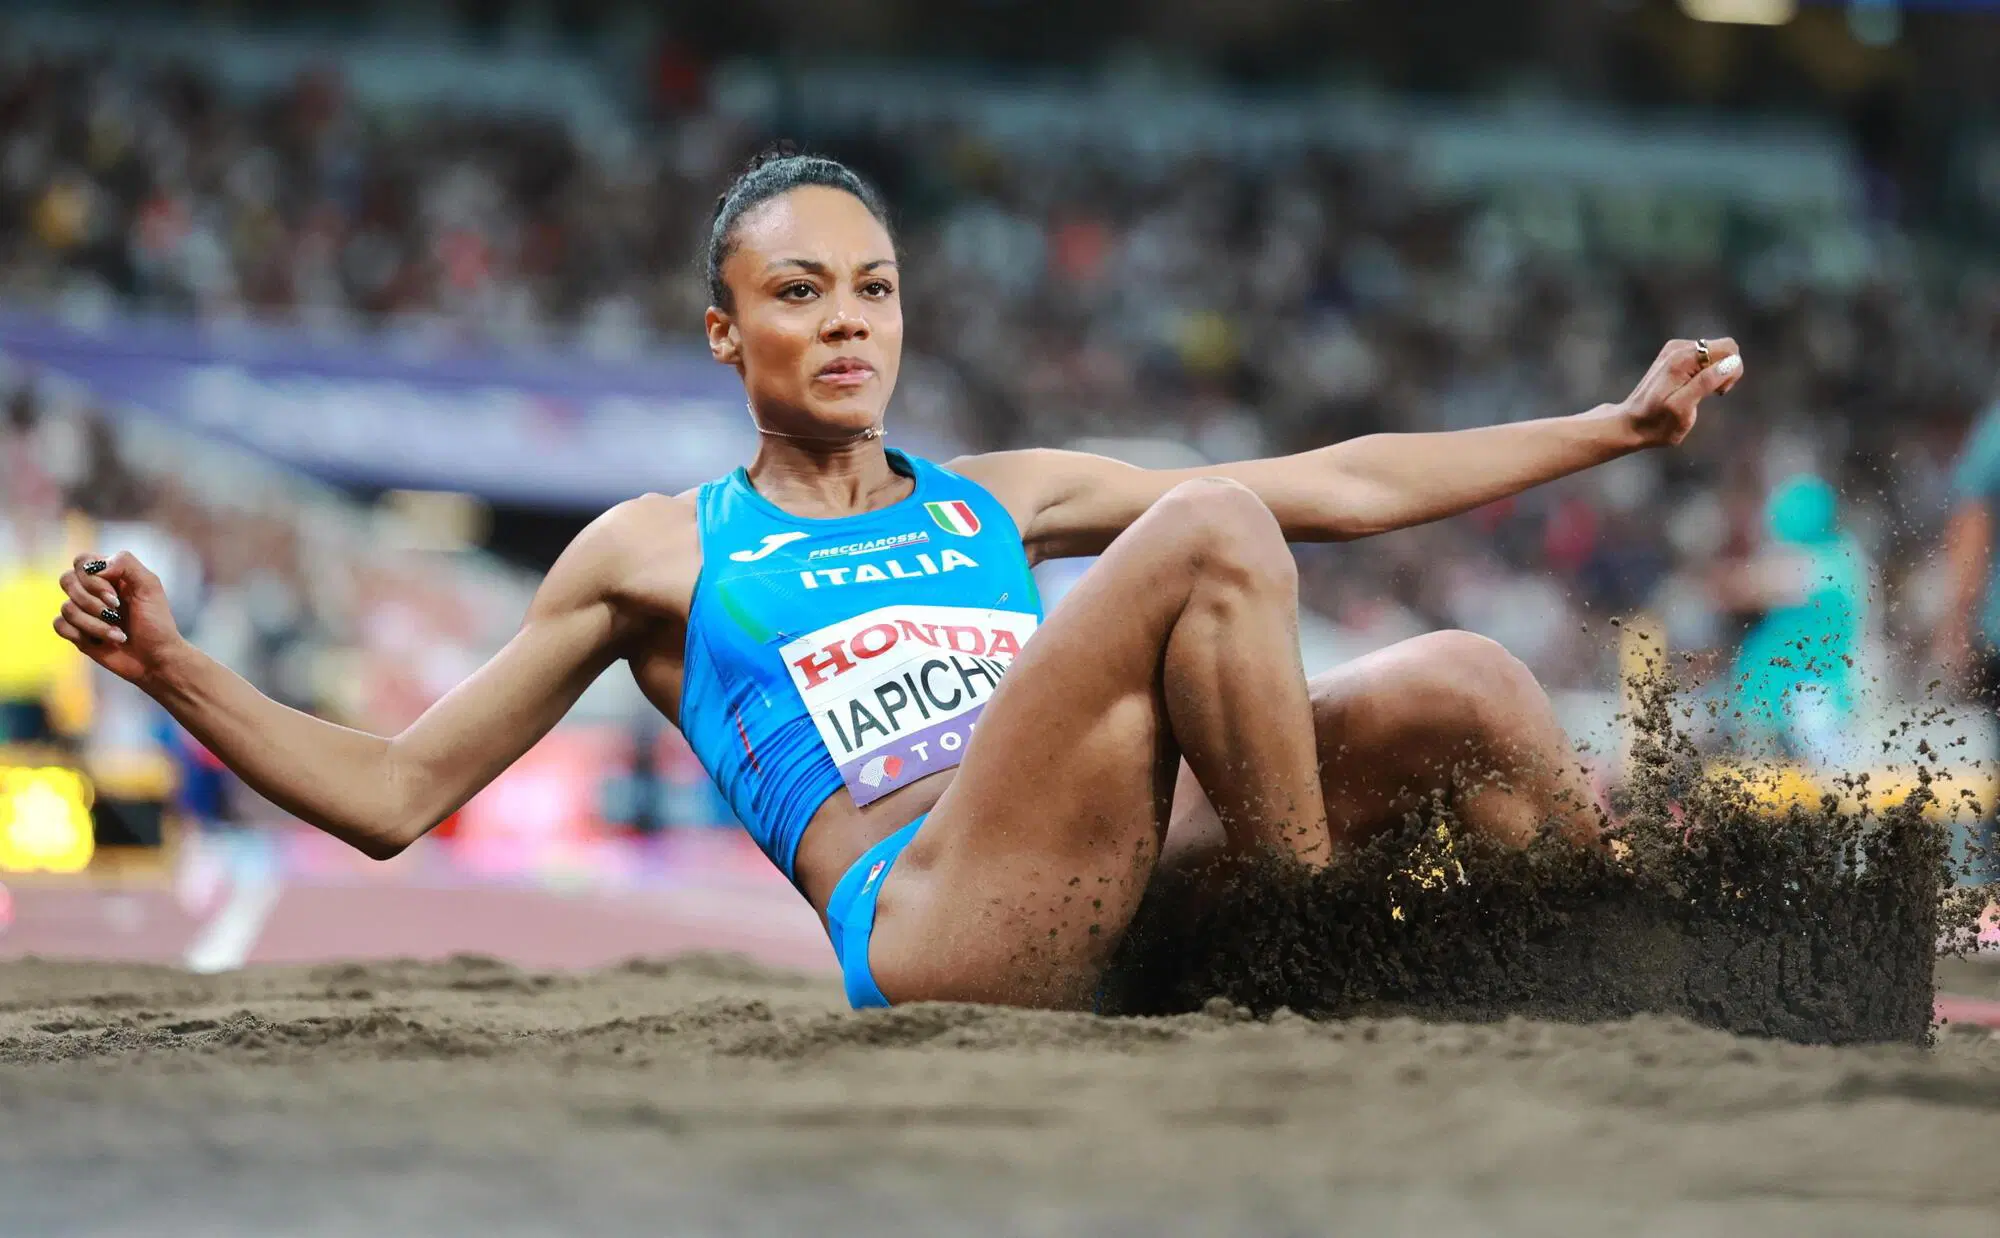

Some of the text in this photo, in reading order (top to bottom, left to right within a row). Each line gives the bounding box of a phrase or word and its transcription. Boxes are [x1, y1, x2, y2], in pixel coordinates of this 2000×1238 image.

[809, 531, 928, 559] FRECCIAROSSA
[800, 549, 979, 589] ITALIA
[793, 620, 1022, 690] HONDA
[910, 723, 975, 761] TO
